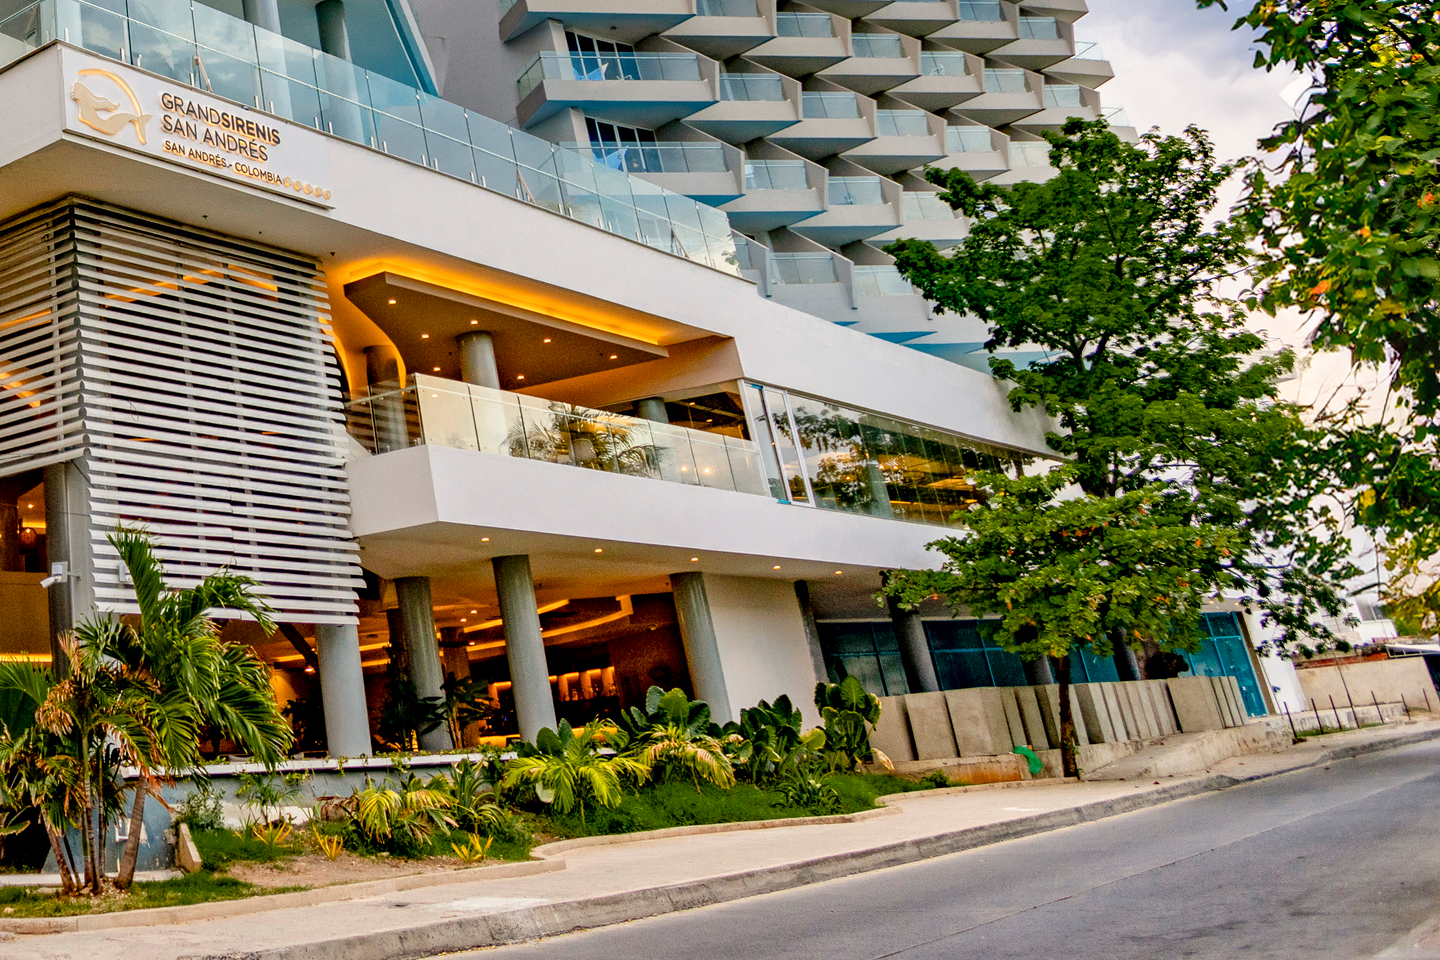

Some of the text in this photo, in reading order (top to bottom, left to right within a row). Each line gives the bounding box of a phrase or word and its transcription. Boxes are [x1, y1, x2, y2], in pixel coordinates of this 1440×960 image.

[161, 92, 281, 145] GRANDSIRENIS
[162, 114, 269, 162] SAN ANDRÉS
[165, 140, 186, 155] SAN
[235, 162, 283, 185] COLOMBIA
